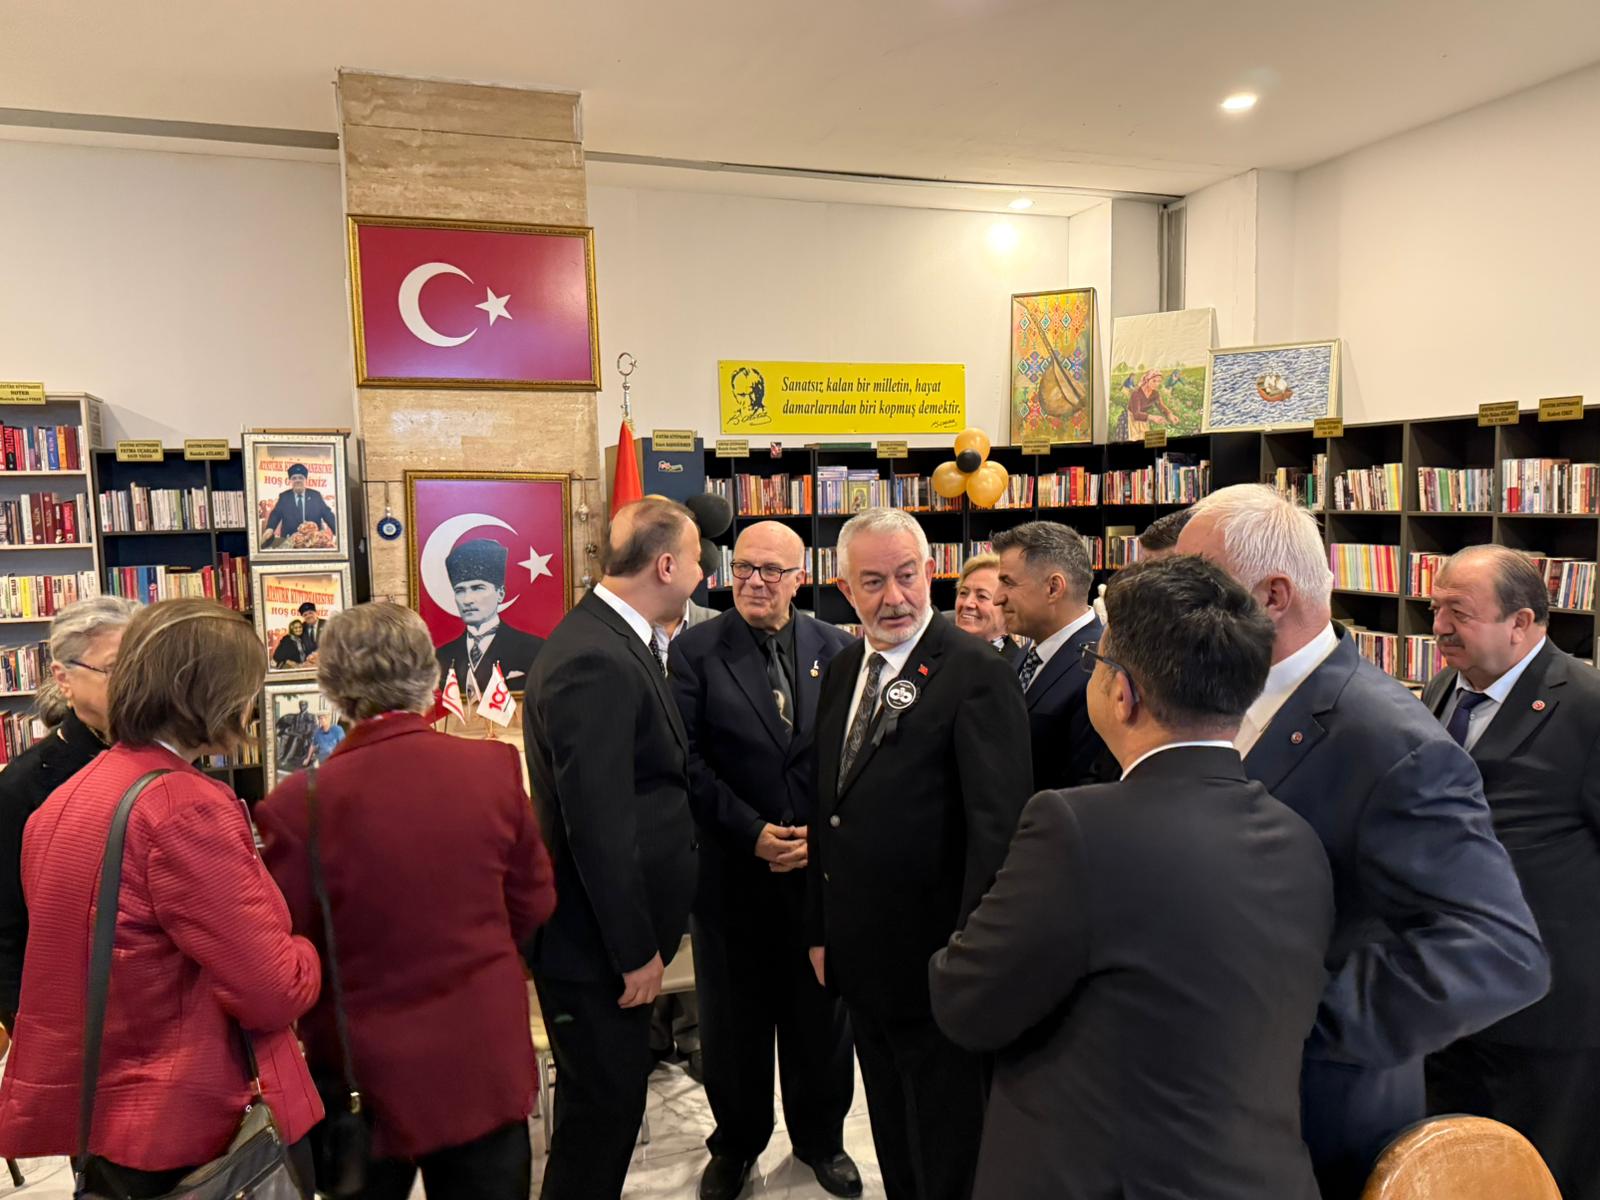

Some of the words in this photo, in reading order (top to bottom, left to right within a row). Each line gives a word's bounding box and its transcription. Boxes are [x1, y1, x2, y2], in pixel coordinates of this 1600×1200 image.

[782, 376, 823, 393] Sanatsız
[826, 377, 854, 392] kalan
[857, 377, 871, 392] bir
[873, 378, 912, 395] milletin,
[915, 378, 942, 396] hayat
[783, 399, 857, 415] damarlarından
[859, 399, 877, 415] biri
[879, 400, 916, 418] kopmuş
[918, 400, 961, 415] demektir.
[4, 427, 14, 454] NUTUK
[264, 476, 283, 488] HOŞ
[272, 607, 288, 617] HOŞ
